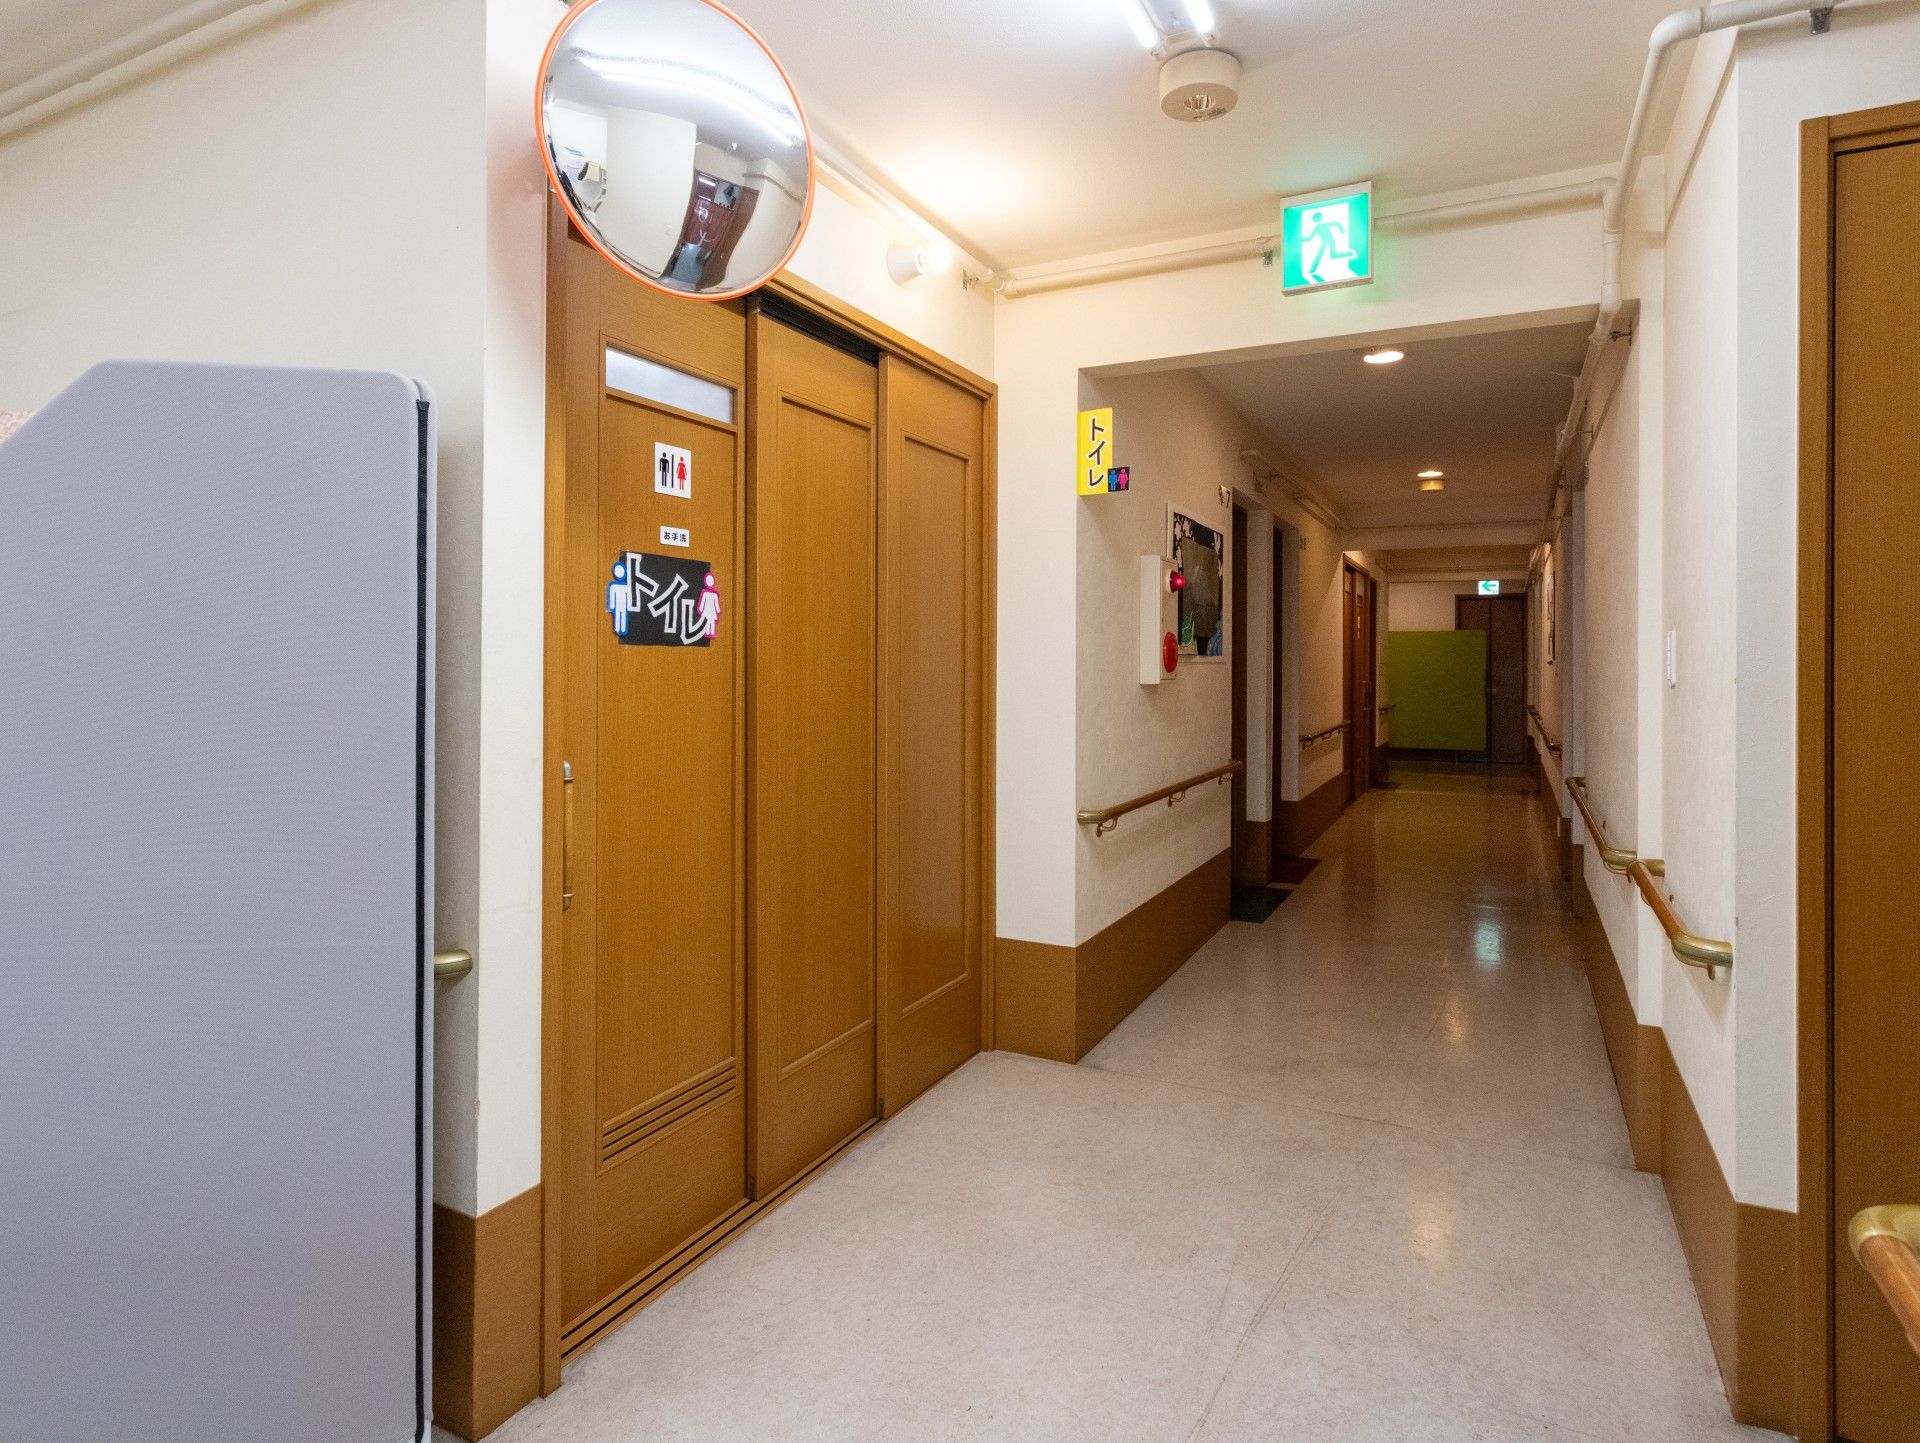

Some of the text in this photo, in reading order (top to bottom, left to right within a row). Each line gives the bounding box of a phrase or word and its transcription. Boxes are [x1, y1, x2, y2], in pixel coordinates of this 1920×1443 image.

[1088, 418, 1105, 486] トイレ
[663, 531, 687, 542] お手洗
[626, 552, 709, 645] トイレ
